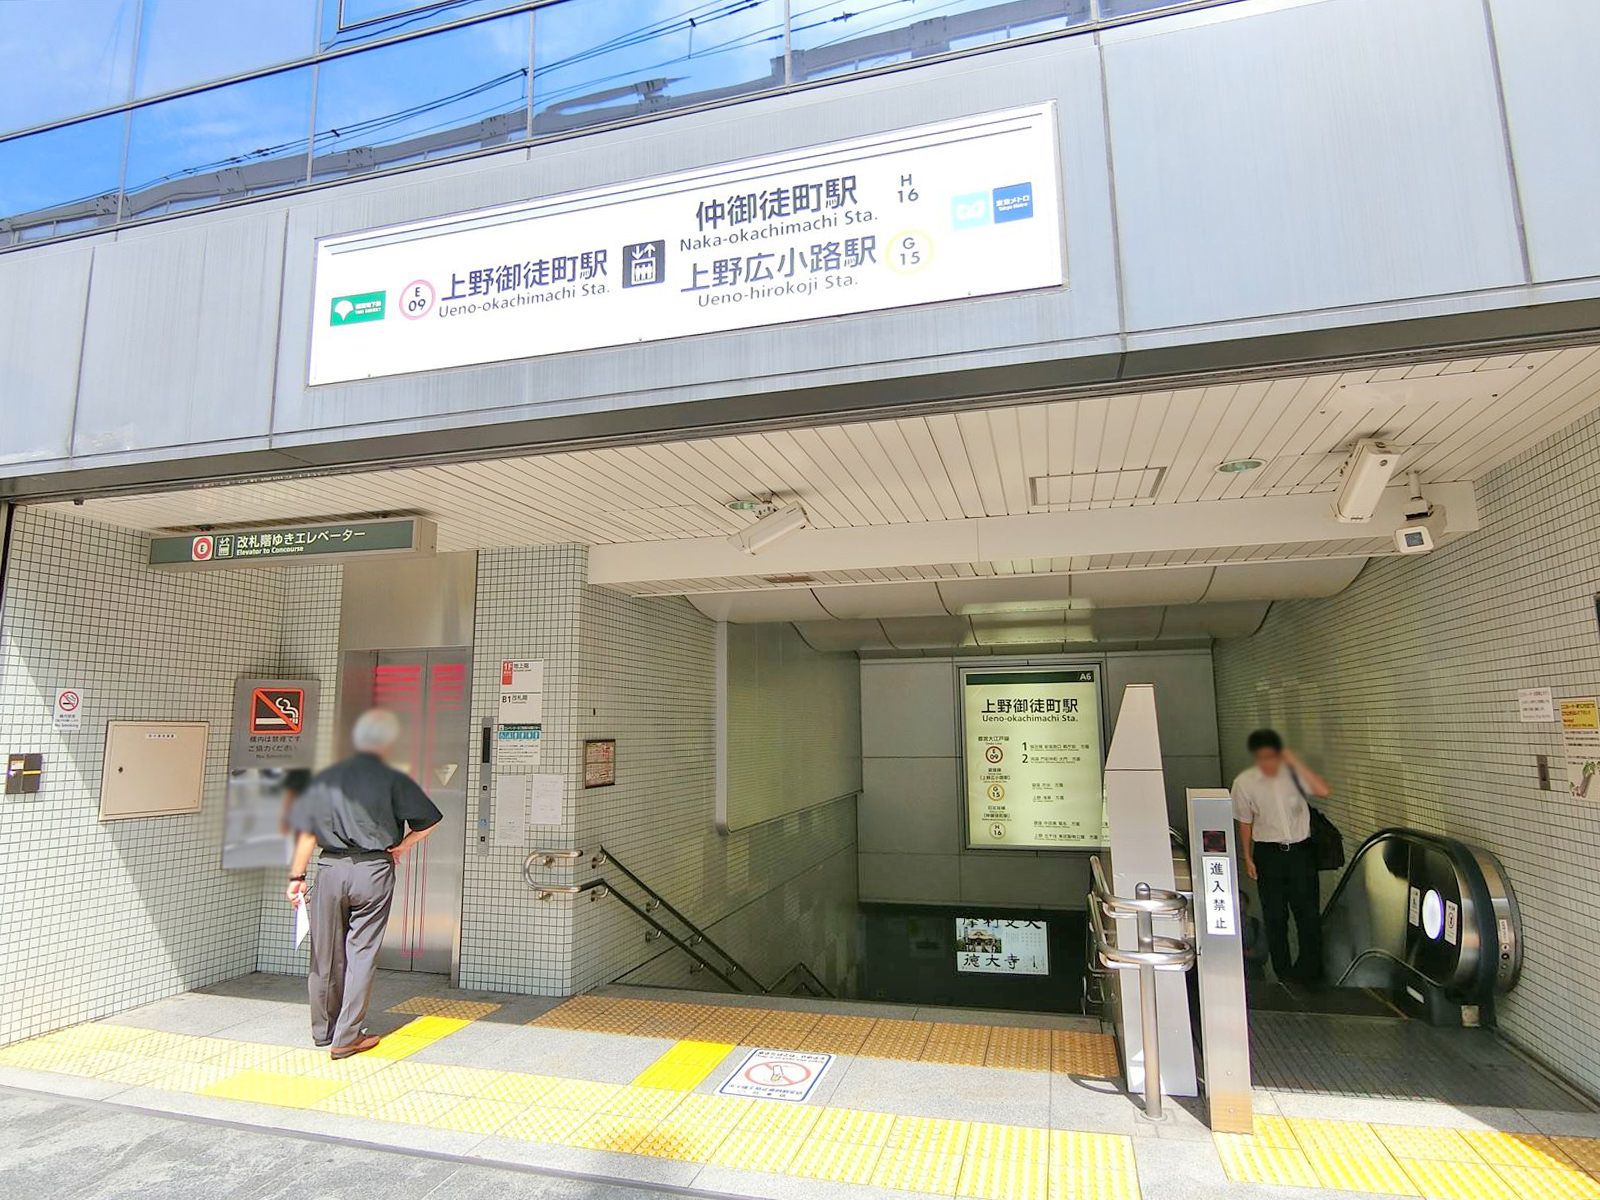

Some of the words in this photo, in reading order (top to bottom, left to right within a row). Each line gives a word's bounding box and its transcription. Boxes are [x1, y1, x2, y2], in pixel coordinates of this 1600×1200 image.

[900, 173, 913, 187] H
[694, 174, 858, 233] 仲御徒町駅
[896, 187, 920, 204] 16
[679, 213, 838, 252] Naka-okachimachi
[844, 207, 879, 224] Sta.
[902, 236, 916, 251] G
[680, 234, 878, 293] 上野広小路駅
[899, 250, 921, 267] 15
[440, 248, 609, 302] 上野御徒町駅
[414, 286, 421, 298] E
[696, 278, 818, 307] Ueno-hirokoji
[824, 273, 859, 289] Sta.
[407, 297, 427, 313] 09
[438, 285, 577, 319] Ueno-okachimachi
[581, 281, 611, 298] Sta.
[236, 529, 366, 549] 改札階ゆきエレベーター
[236, 548, 262, 556] Elevator
[271, 546, 304, 554] Concourse
[503, 662, 513, 671] 1F
[1079, 673, 1092, 681] A6
[502, 695, 511, 703] B1
[981, 698, 1079, 714] 上野御徒町駅
[982, 714, 1060, 723] Ueno-okachimachi
[1061, 714, 1079, 723] Sta.
[1021, 742, 1028, 751] 1
[1021, 754, 1029, 764] 2
[1210, 862, 1228, 929] 進入禁止
